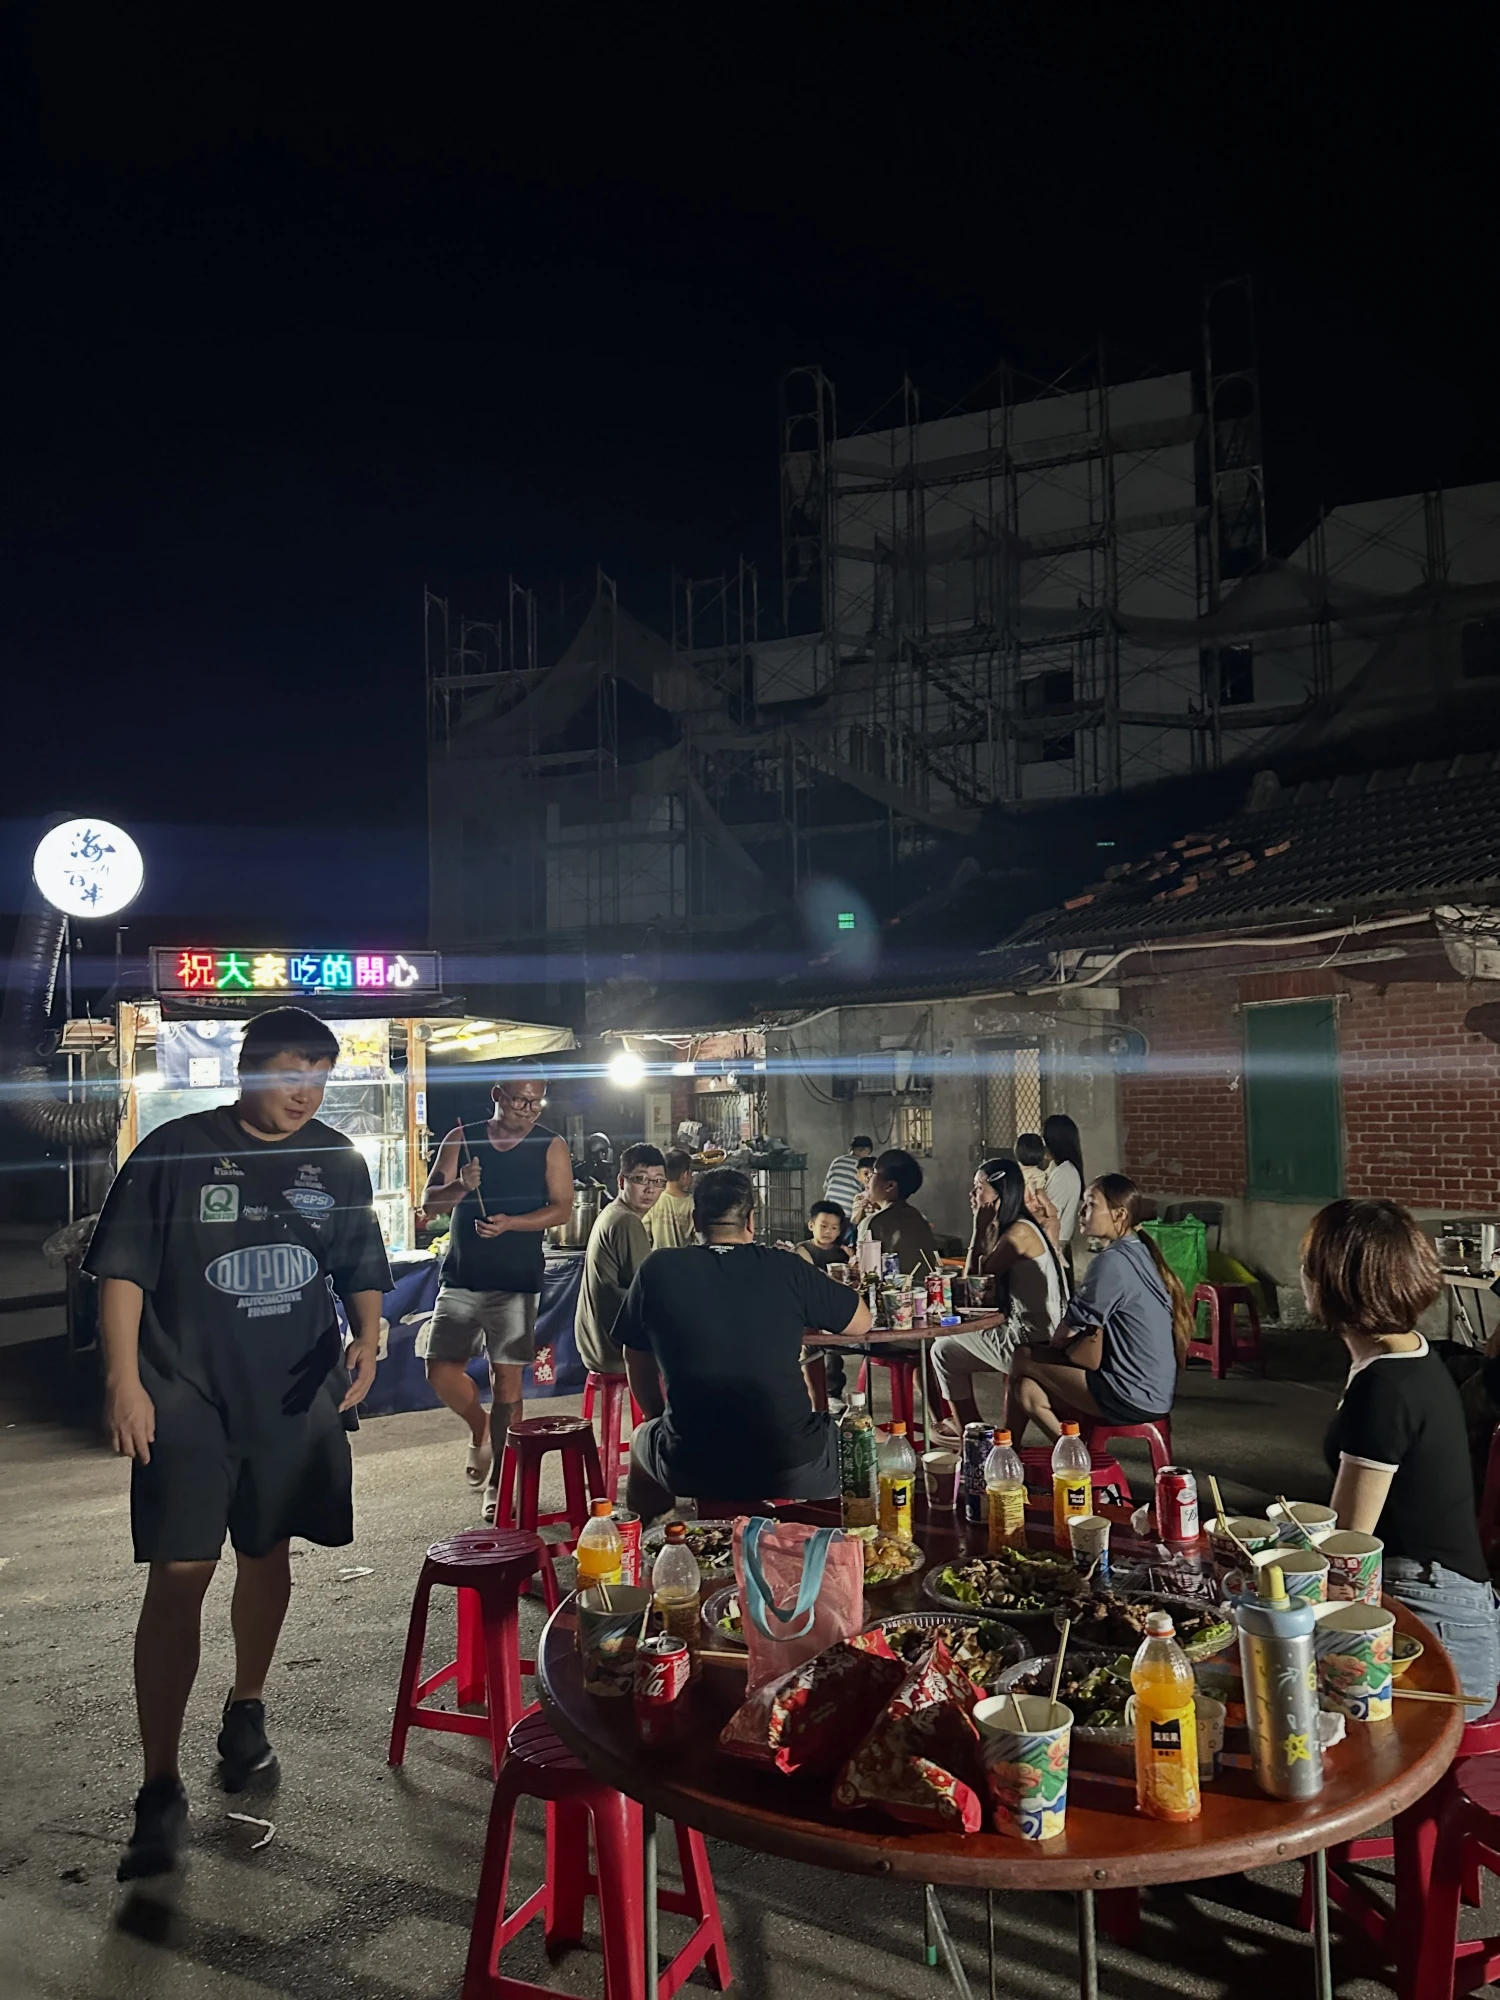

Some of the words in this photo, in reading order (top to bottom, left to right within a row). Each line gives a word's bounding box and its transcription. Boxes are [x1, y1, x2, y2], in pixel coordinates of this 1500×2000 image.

[177, 952, 419, 988] 祝大家吃的開心
[294, 1193, 329, 1207] PEPSI
[236, 1291, 303, 1308] AUTOMOTIVE
[247, 1303, 292, 1318] FINISHES
